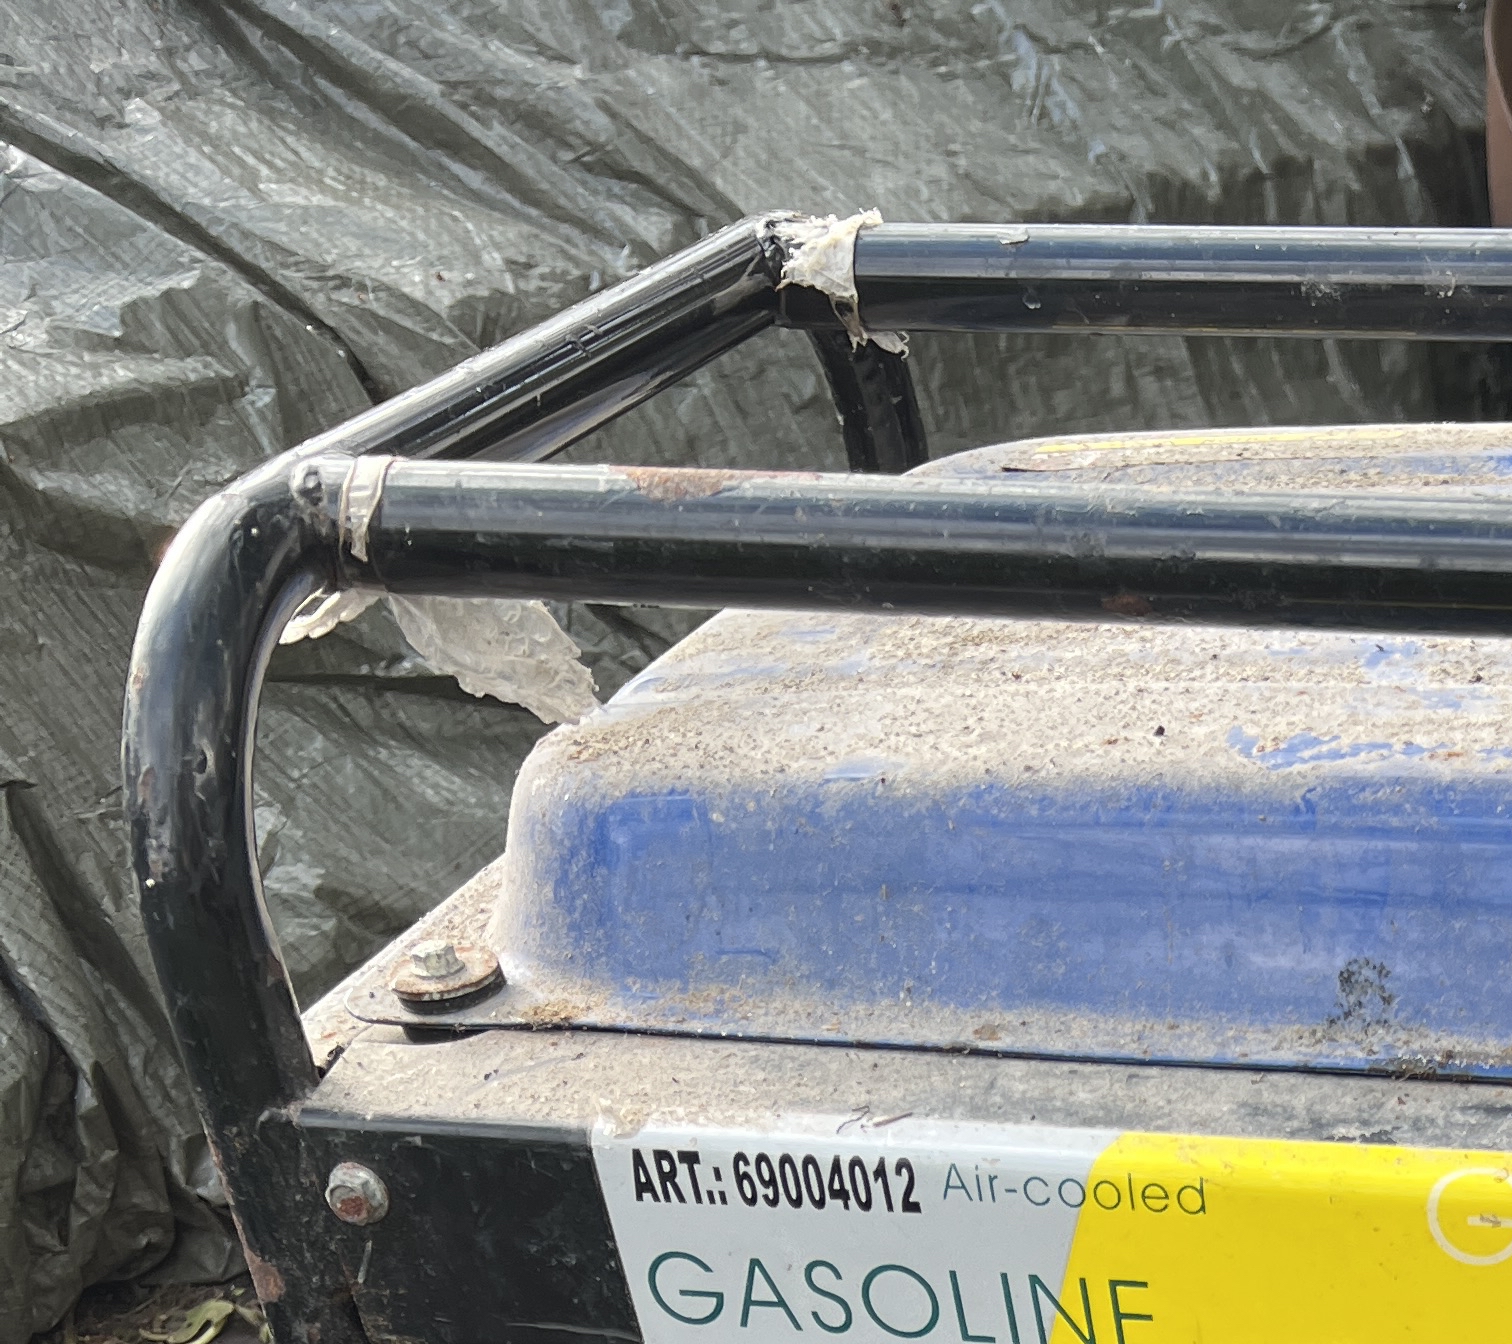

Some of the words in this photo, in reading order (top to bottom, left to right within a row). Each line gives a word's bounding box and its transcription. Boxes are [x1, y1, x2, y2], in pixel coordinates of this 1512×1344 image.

[631, 1148, 727, 1206] ART.:
[733, 1150, 922, 1214] 69004012
[941, 1162, 1209, 1217] Air-cooled
